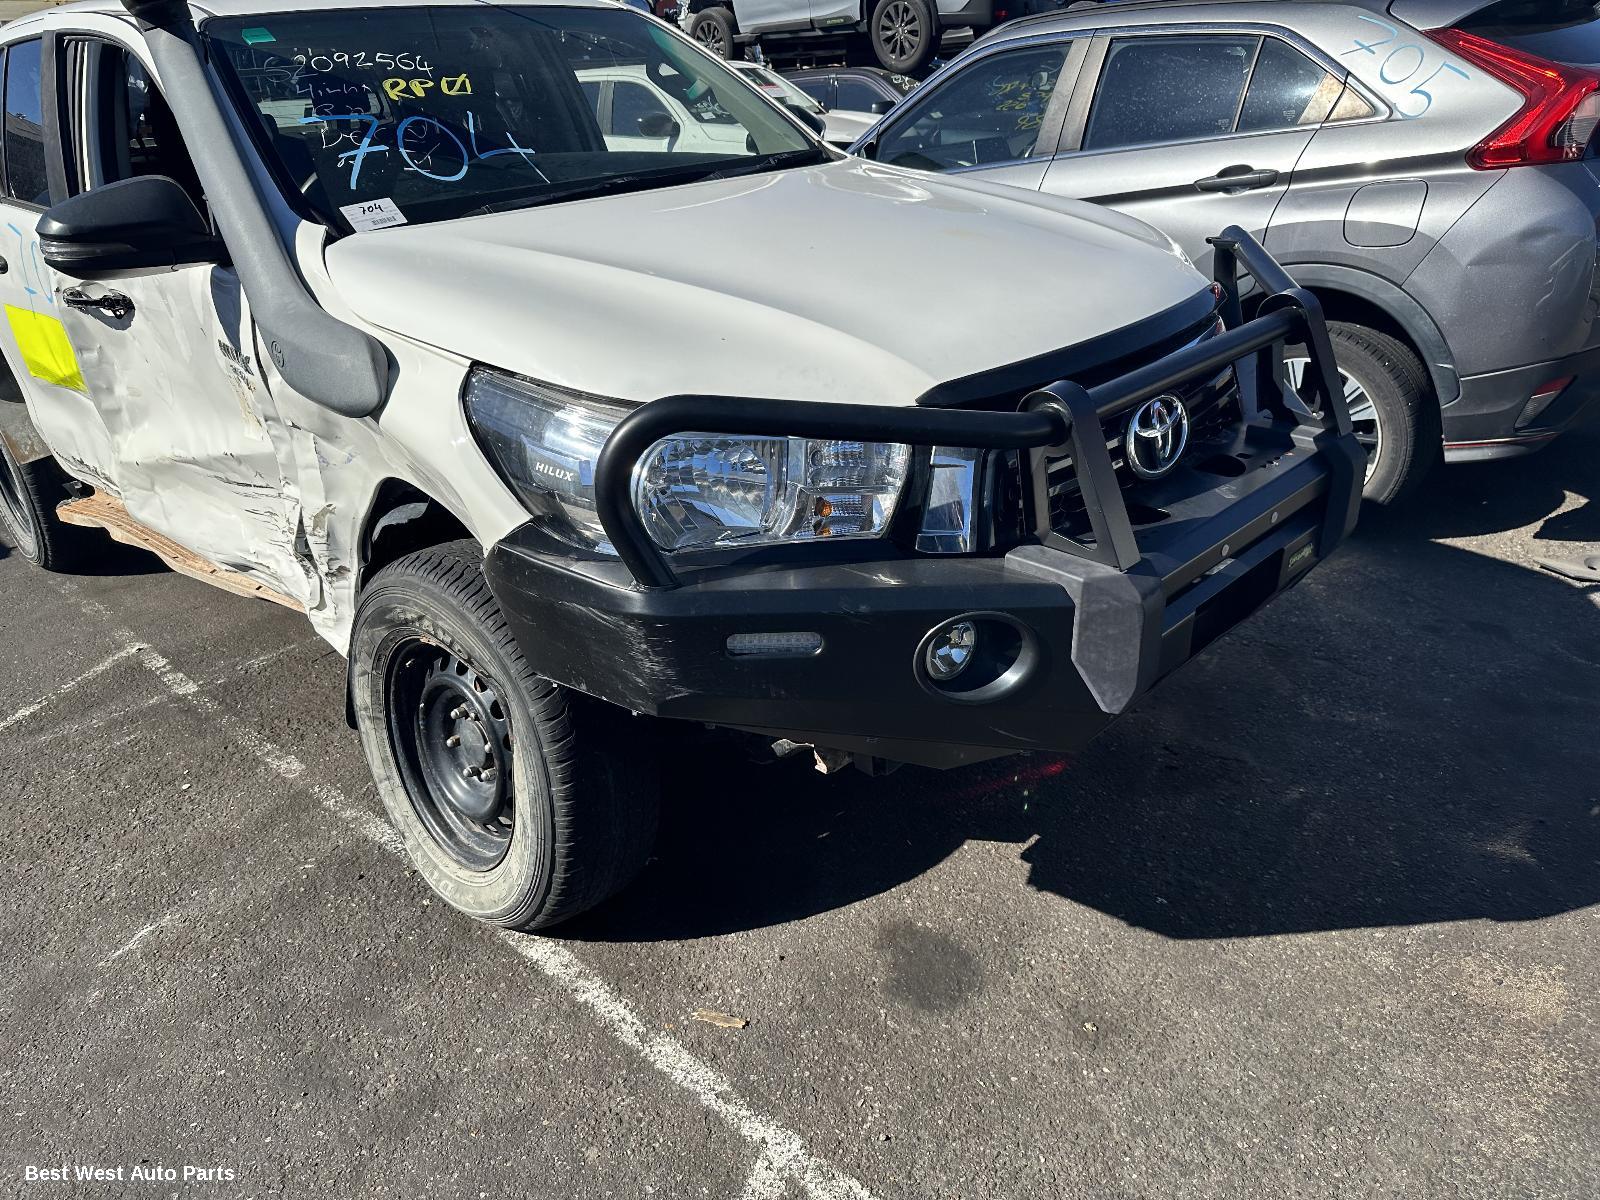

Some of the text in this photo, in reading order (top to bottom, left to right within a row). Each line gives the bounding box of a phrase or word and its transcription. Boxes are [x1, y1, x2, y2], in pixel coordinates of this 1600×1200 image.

[1340, 15, 1470, 121] 705
[298, 110, 550, 190] 704
[358, 203, 385, 215] 704
[535, 461, 574, 482] HILUX
